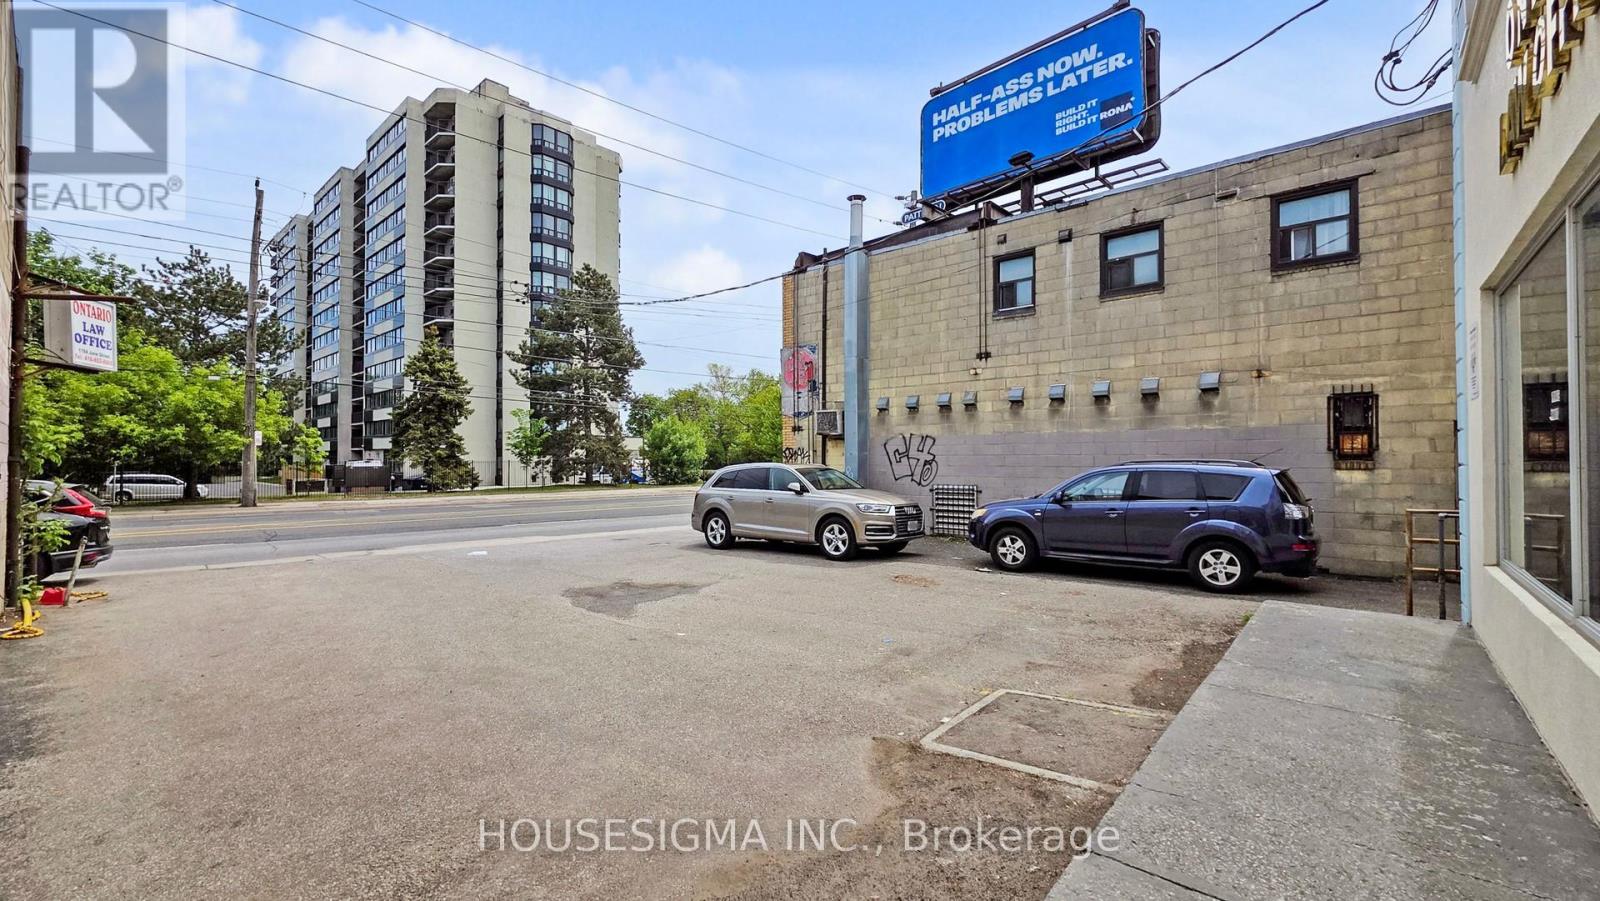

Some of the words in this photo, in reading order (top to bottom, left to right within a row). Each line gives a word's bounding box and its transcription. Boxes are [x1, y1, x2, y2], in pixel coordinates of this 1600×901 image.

[932, 72, 1034, 127] HALF-ASS
[1037, 43, 1103, 83] NOW.
[932, 86, 1044, 143] PROBLEMS
[1047, 52, 1134, 97] LATER.
[1055, 103, 1086, 120] BUILD
[1087, 98, 1098, 109] IT
[1055, 110, 1090, 128] RIGHT.
[1055, 118, 1086, 136] BUILD
[1087, 114, 1098, 125] IT
[1100, 102, 1133, 120] RONA
[73, 300, 112, 323] ONTARIO
[82, 321, 105, 337] LAW
[74, 333, 113, 351] OFFICE
